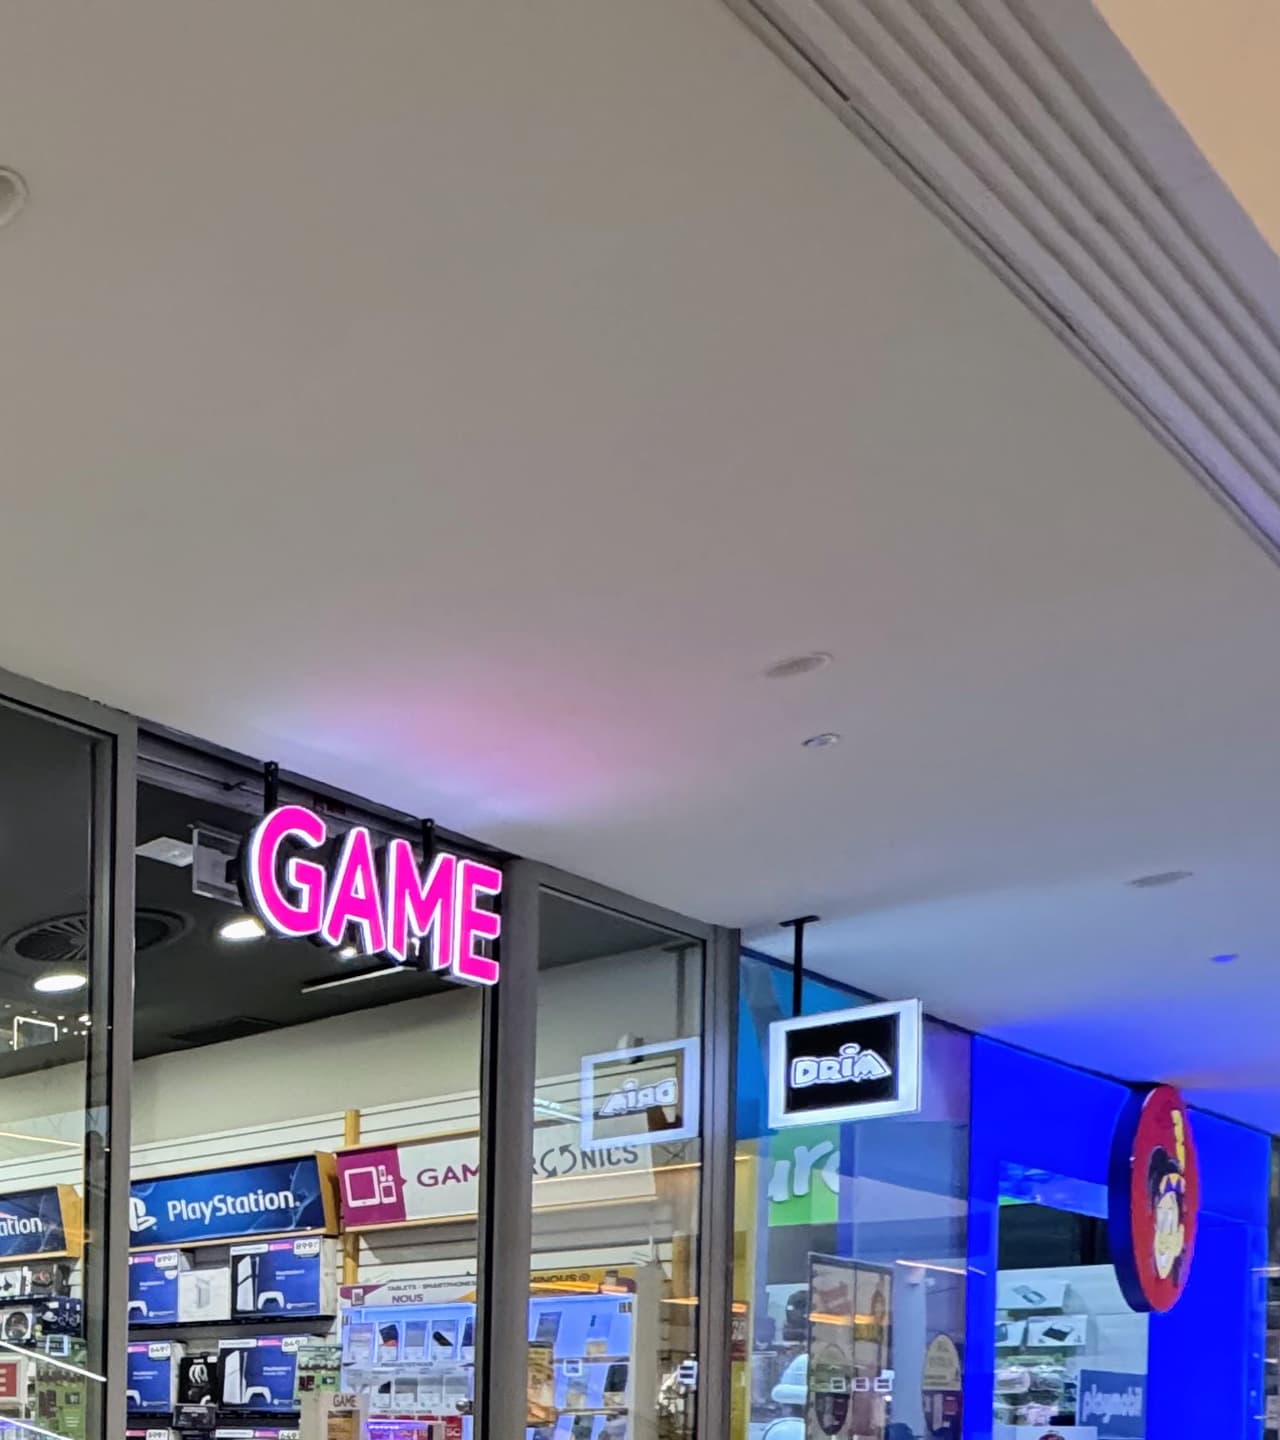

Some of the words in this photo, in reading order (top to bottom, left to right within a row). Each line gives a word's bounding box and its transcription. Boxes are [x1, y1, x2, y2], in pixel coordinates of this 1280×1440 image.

[250, 803, 503, 985] GAME
[790, 1043, 892, 1089] DRIM
[168, 1186, 300, 1224] PlayStation
[392, 1293, 424, 1304] NOUS
[333, 1394, 357, 1408] GAME
